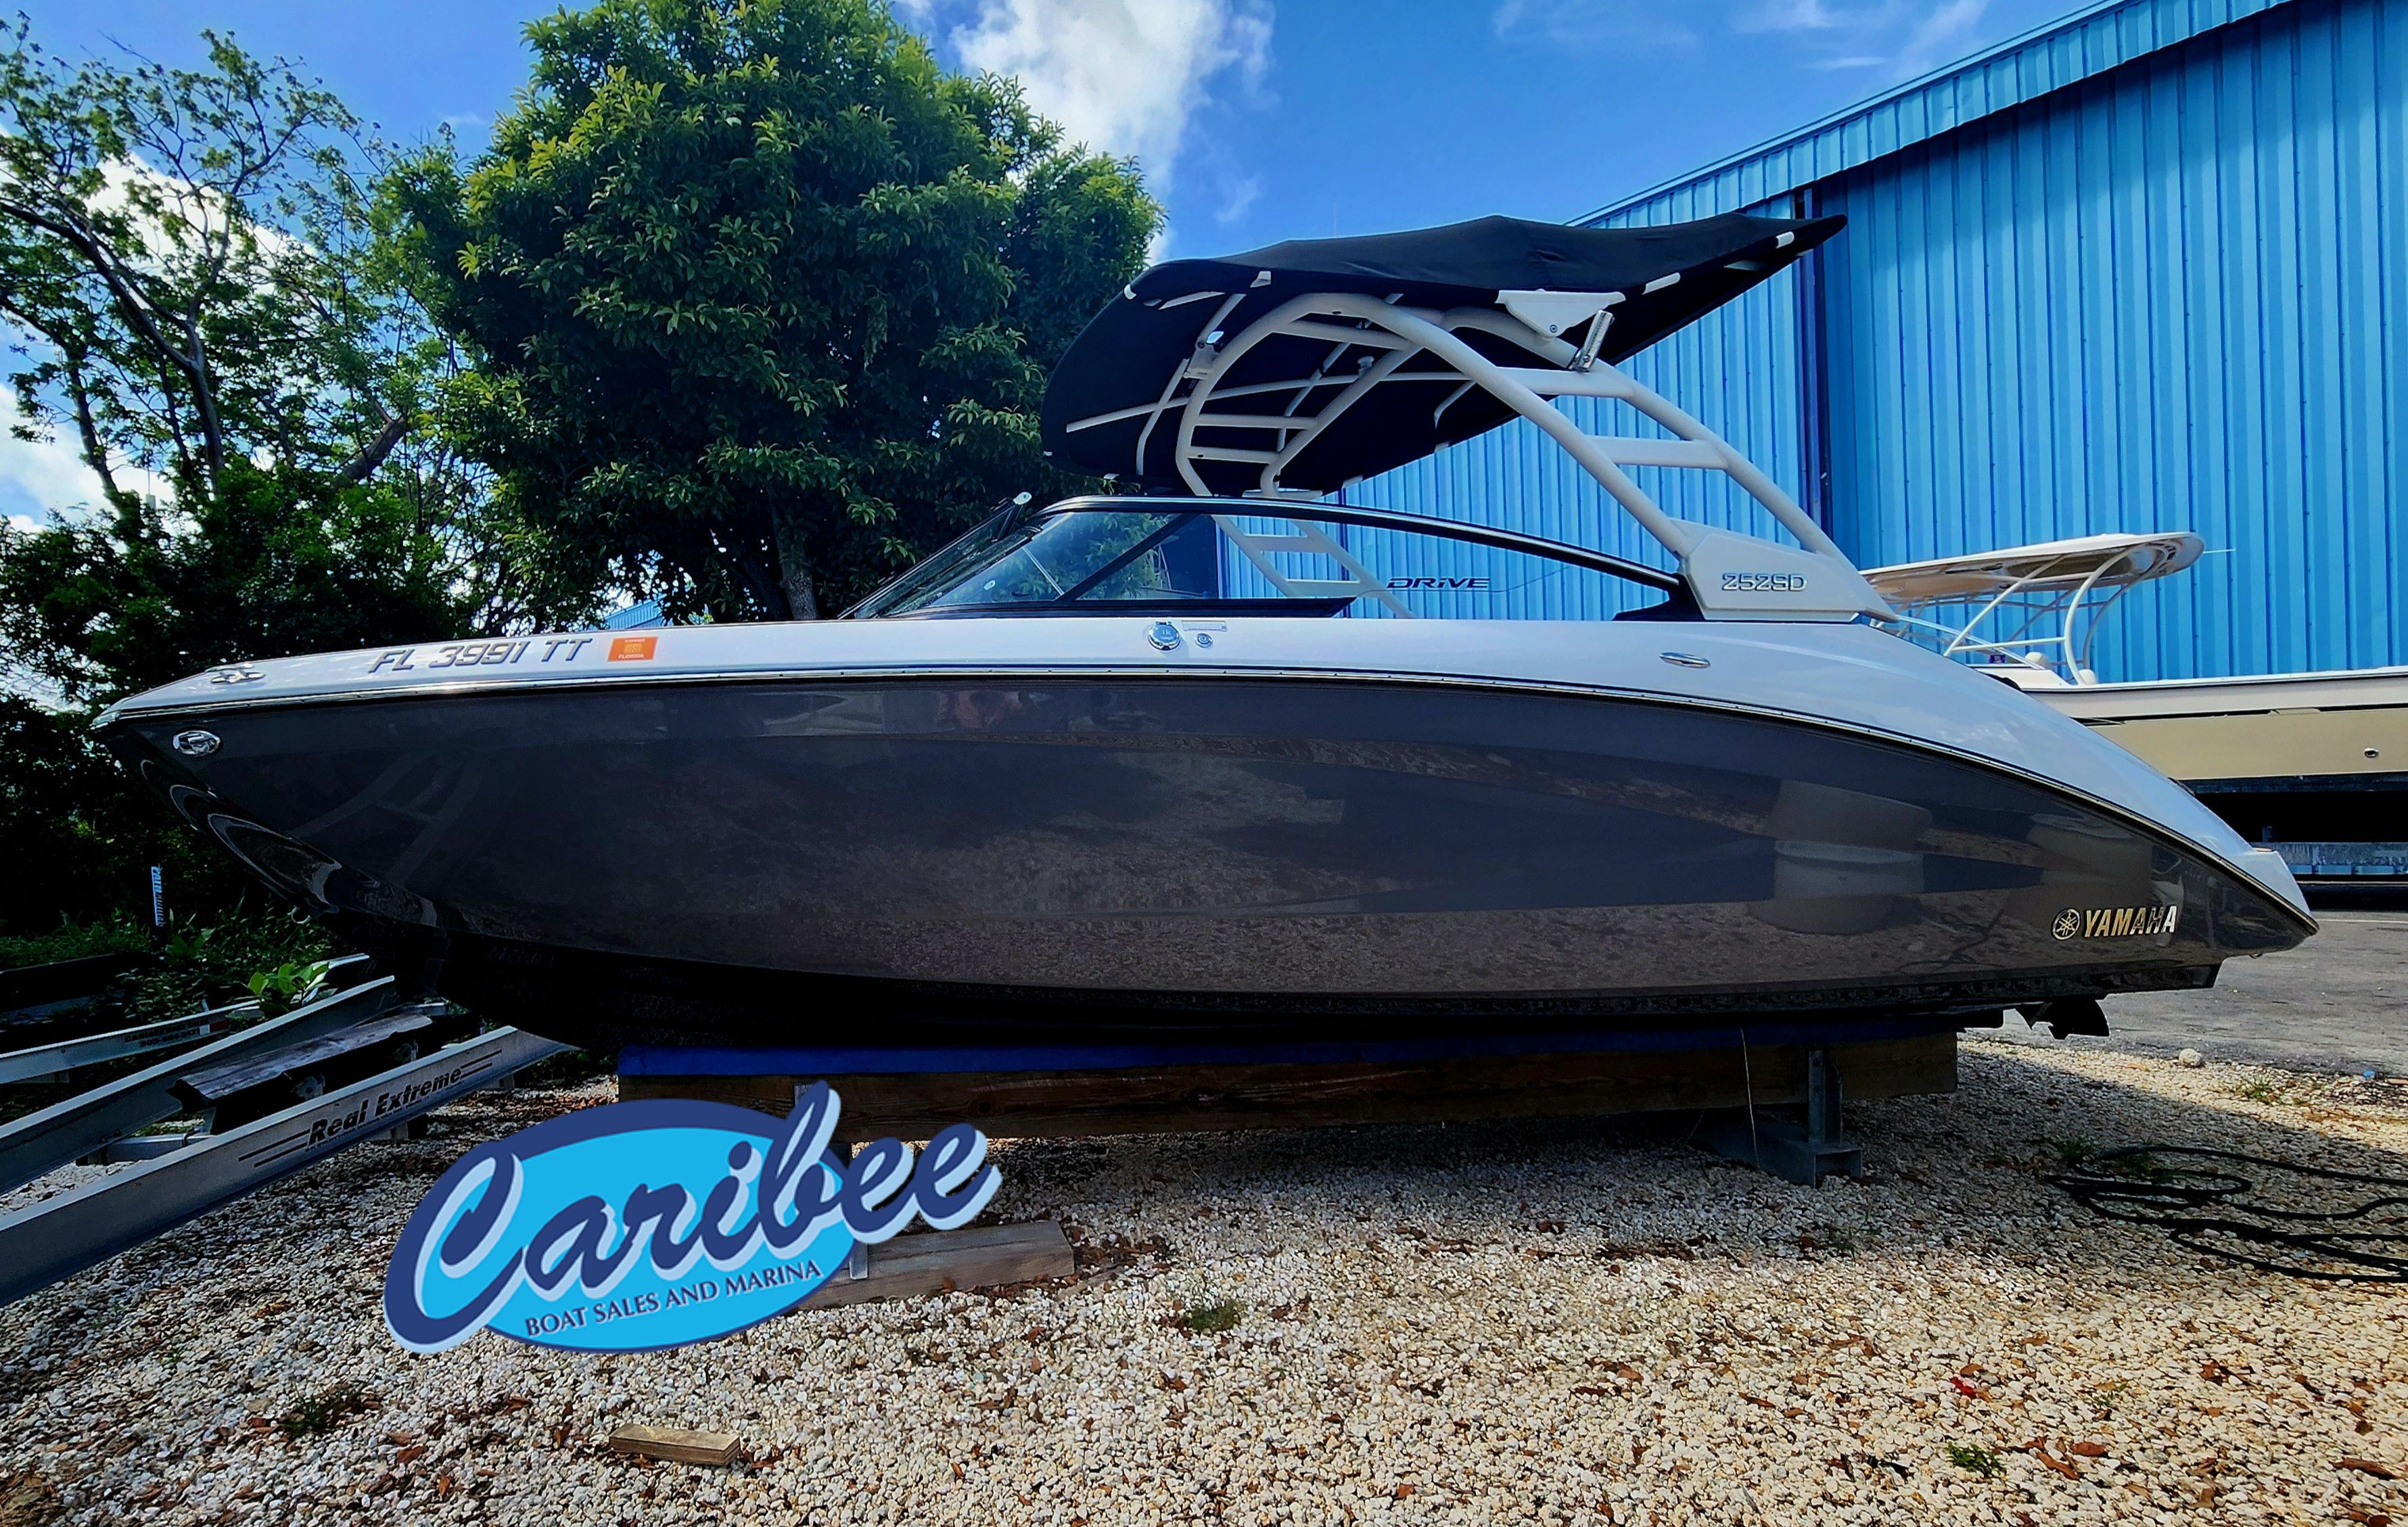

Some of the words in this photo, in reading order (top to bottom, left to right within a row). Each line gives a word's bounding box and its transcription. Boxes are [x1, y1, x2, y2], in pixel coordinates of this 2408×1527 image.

[1722, 573, 1807, 592] 252SD
[367, 649, 415, 673] FL
[429, 641, 531, 668] 3991
[541, 638, 593, 662] TT
[2083, 905, 2178, 938] YAMAHA
[307, 1099, 369, 1146] Real
[375, 1068, 463, 1117] Extreme
